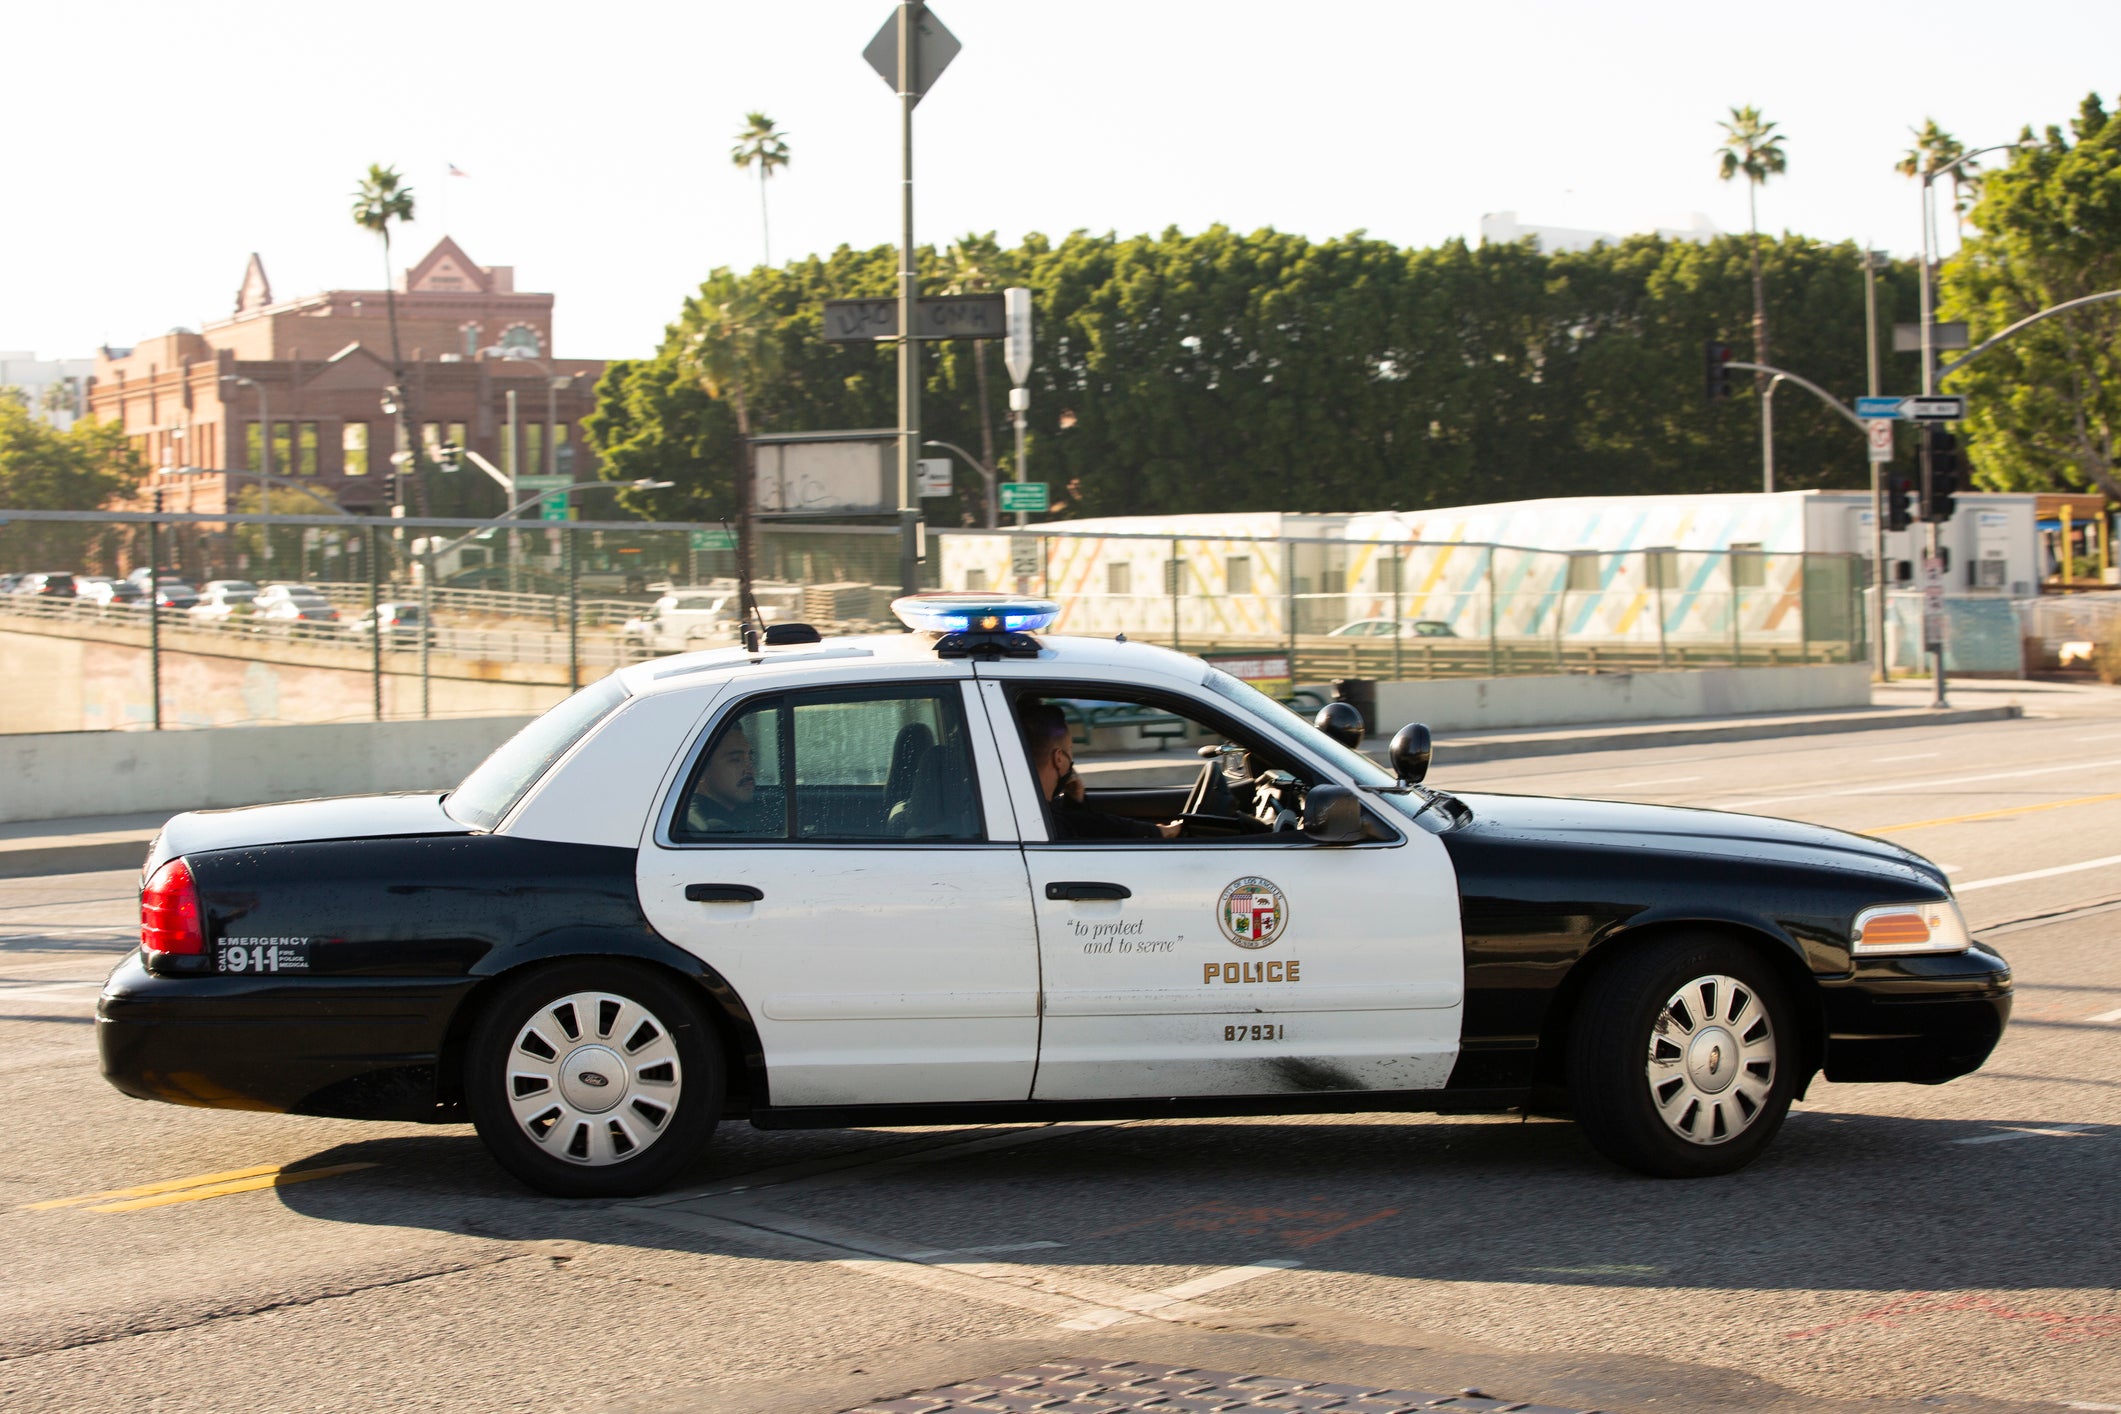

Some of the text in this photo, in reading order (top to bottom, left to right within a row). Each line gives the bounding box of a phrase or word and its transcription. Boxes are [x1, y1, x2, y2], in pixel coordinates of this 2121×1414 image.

[1013, 558, 1037, 573] 25
[1092, 919, 1144, 939] protect
[218, 937, 309, 945] EMERGENCY
[1083, 937, 1114, 954] and
[1119, 938, 1133, 953] to
[218, 948, 227, 972] CALL
[1204, 961, 1300, 984] POLICE
[1225, 1024, 1283, 1041] 87931
